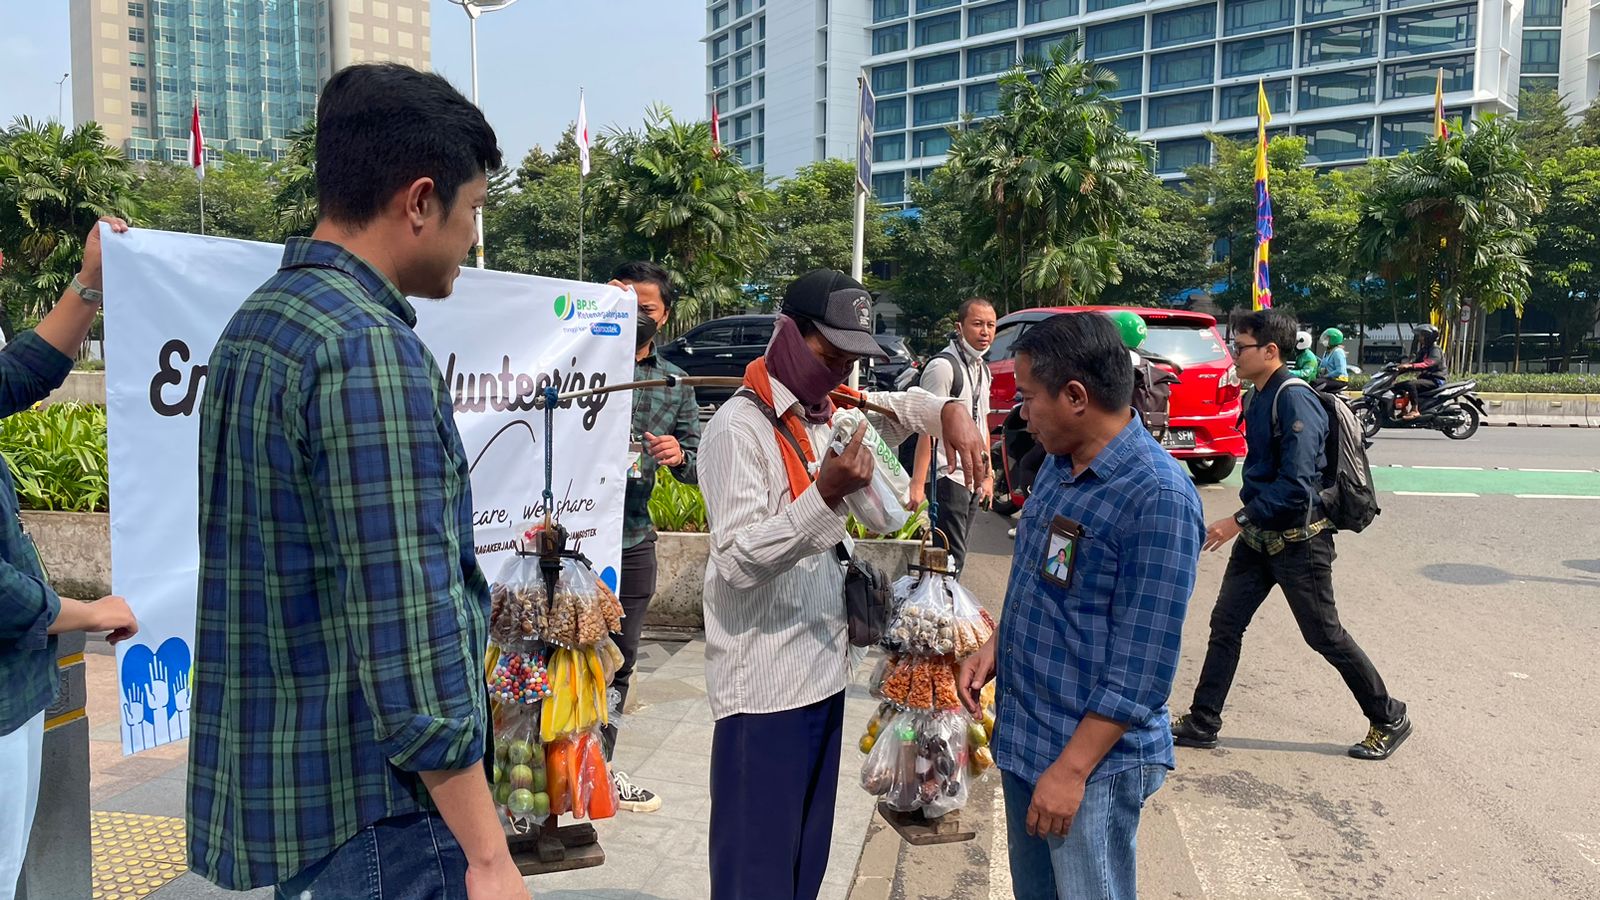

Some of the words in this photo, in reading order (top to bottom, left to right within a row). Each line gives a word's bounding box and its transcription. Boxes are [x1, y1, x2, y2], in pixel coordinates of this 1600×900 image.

[576, 299, 597, 310] BPJS
[445, 352, 610, 432] lunteering
[473, 508, 513, 528] care,
[552, 478, 595, 522] share
[474, 539, 516, 555] NAGAKERJAAN
